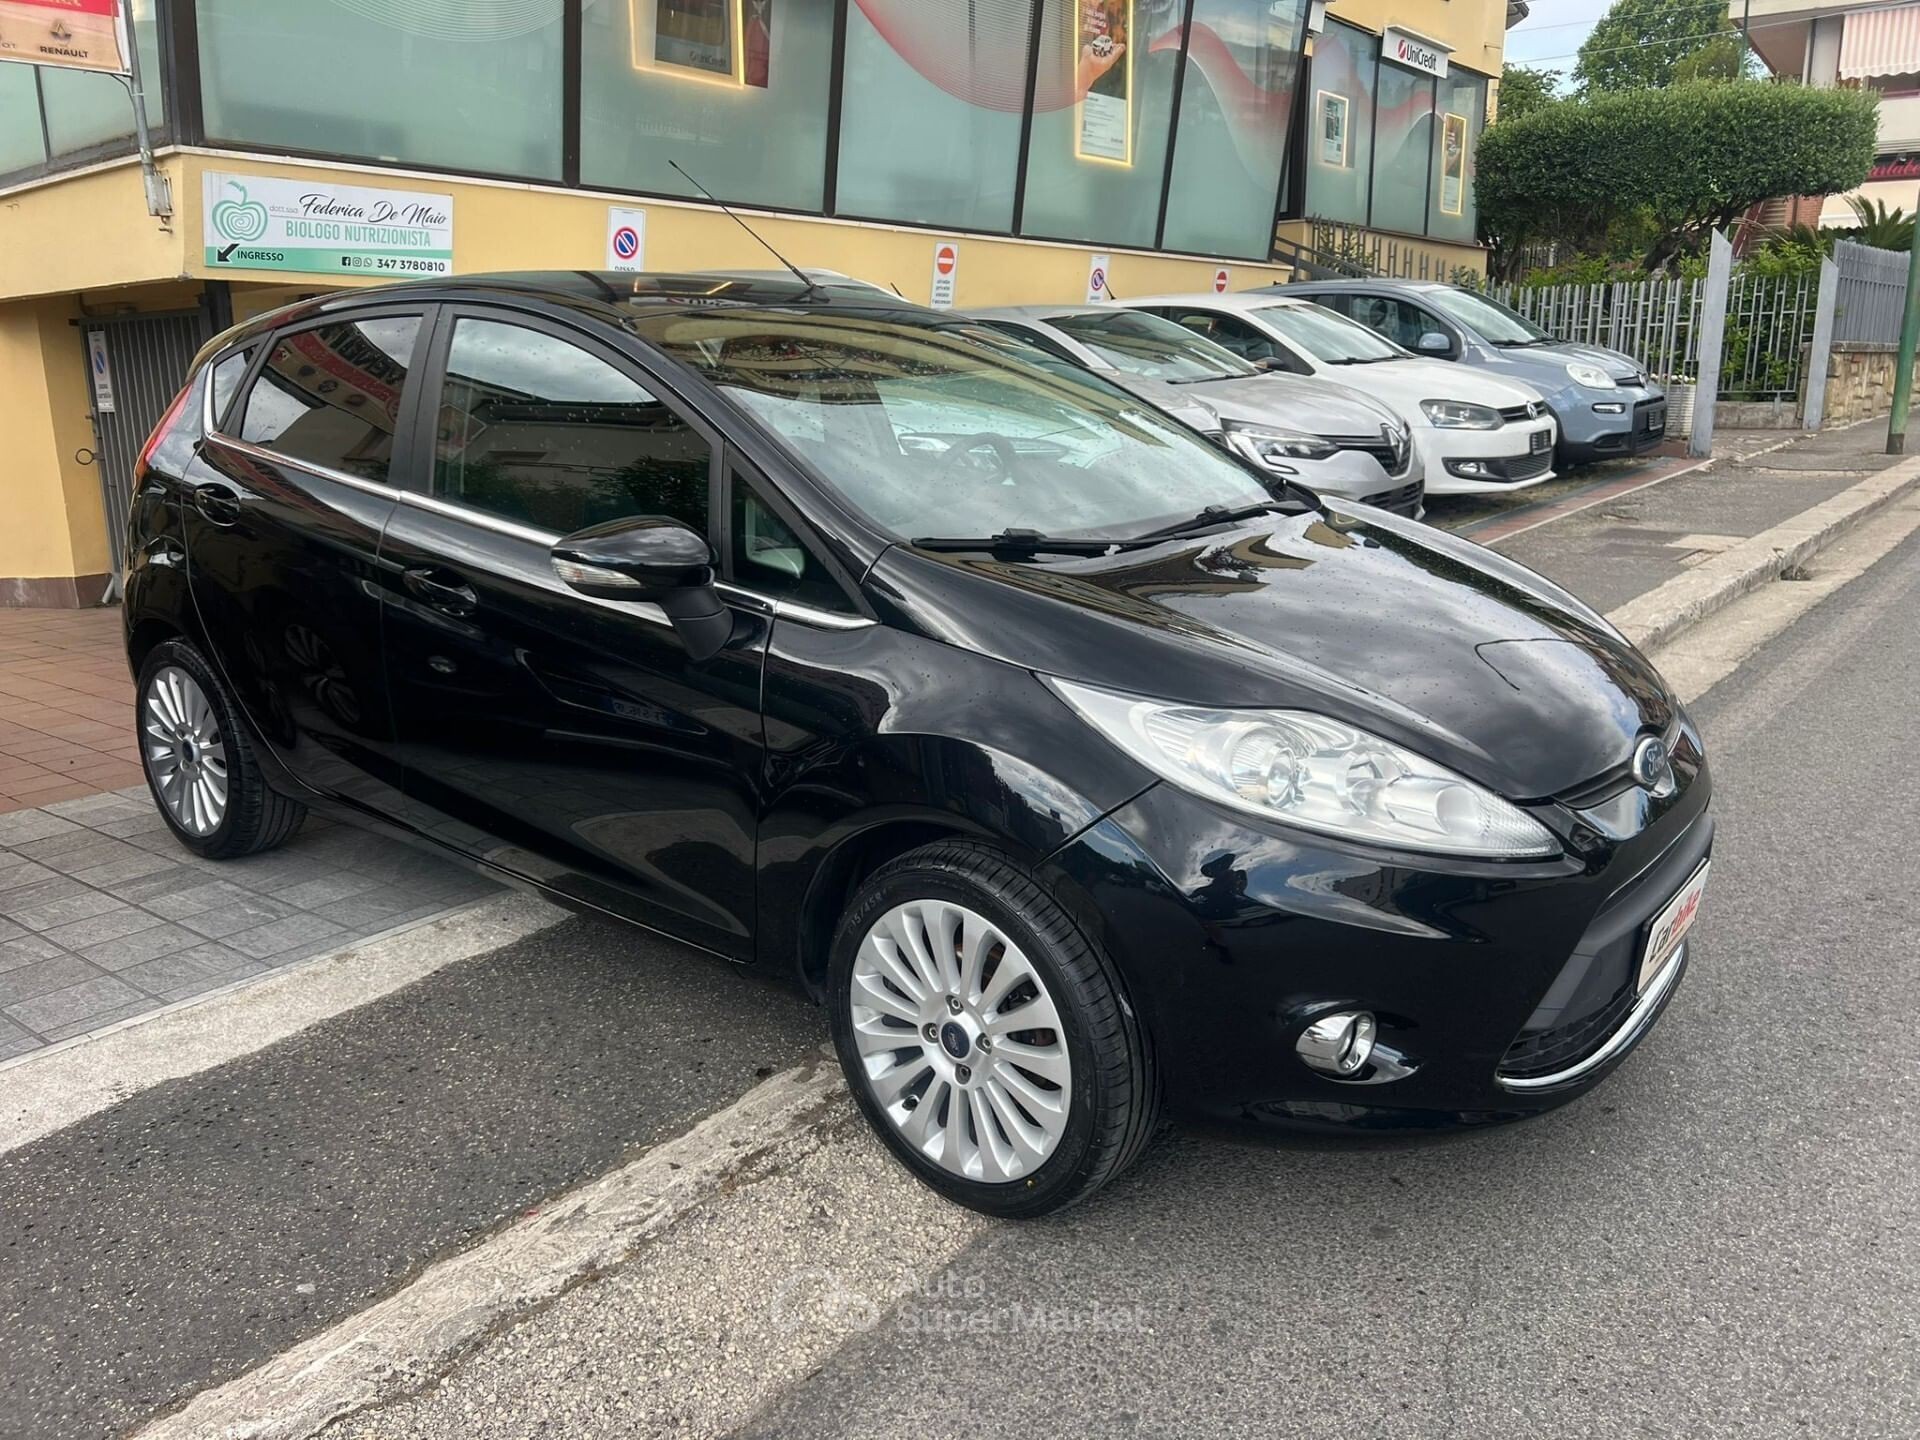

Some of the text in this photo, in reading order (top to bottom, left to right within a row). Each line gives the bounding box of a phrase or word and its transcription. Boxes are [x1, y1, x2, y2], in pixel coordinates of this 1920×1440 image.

[39, 45, 89, 58] RENAULT
[1406, 43, 1437, 71] UniCredit
[299, 193, 365, 218] Federica
[368, 200, 400, 223] De
[401, 202, 447, 228] Maio
[286, 220, 431, 247] BIOLOGO NUTRIZIONISTA
[237, 250, 284, 262] INGRESSO
[377, 258, 446, 272] 347 3780810
